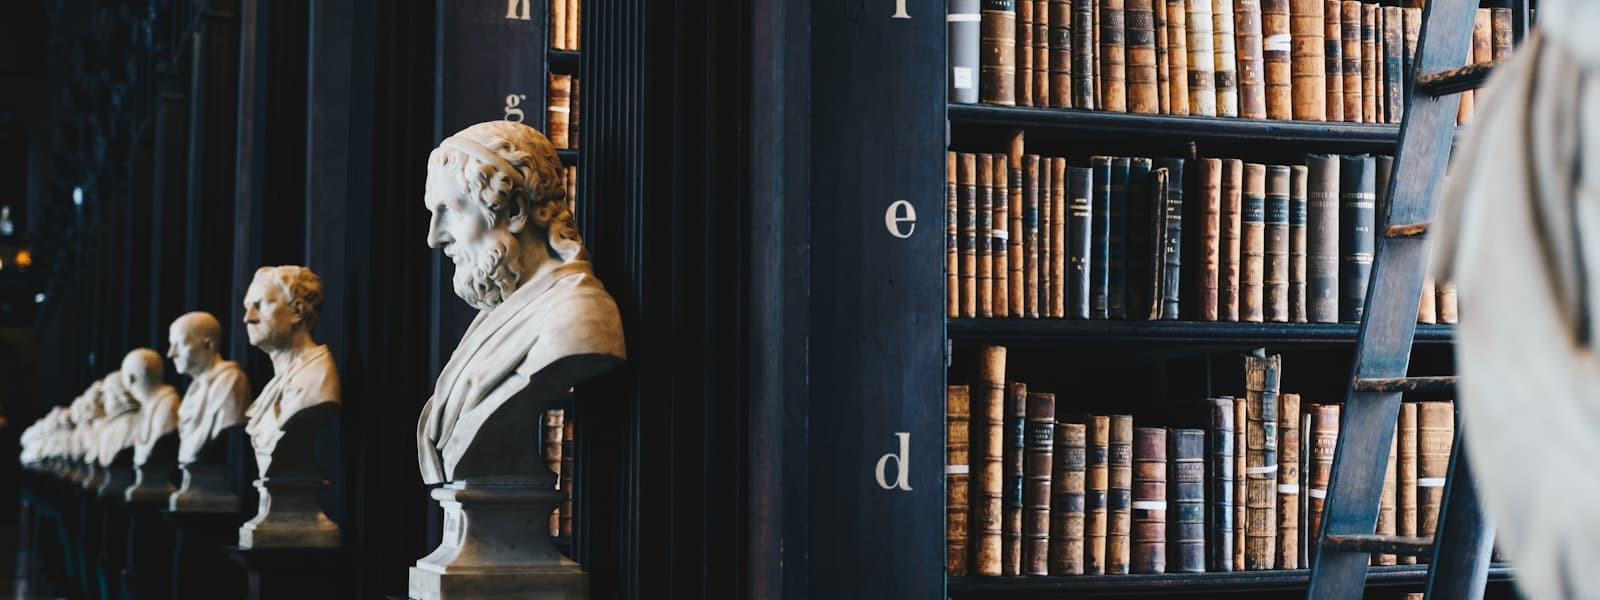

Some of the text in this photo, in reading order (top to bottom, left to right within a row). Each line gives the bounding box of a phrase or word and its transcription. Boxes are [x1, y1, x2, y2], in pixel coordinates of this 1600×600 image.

[504, 94, 526, 122] g
[885, 199, 917, 239] e
[875, 432, 913, 491] d
